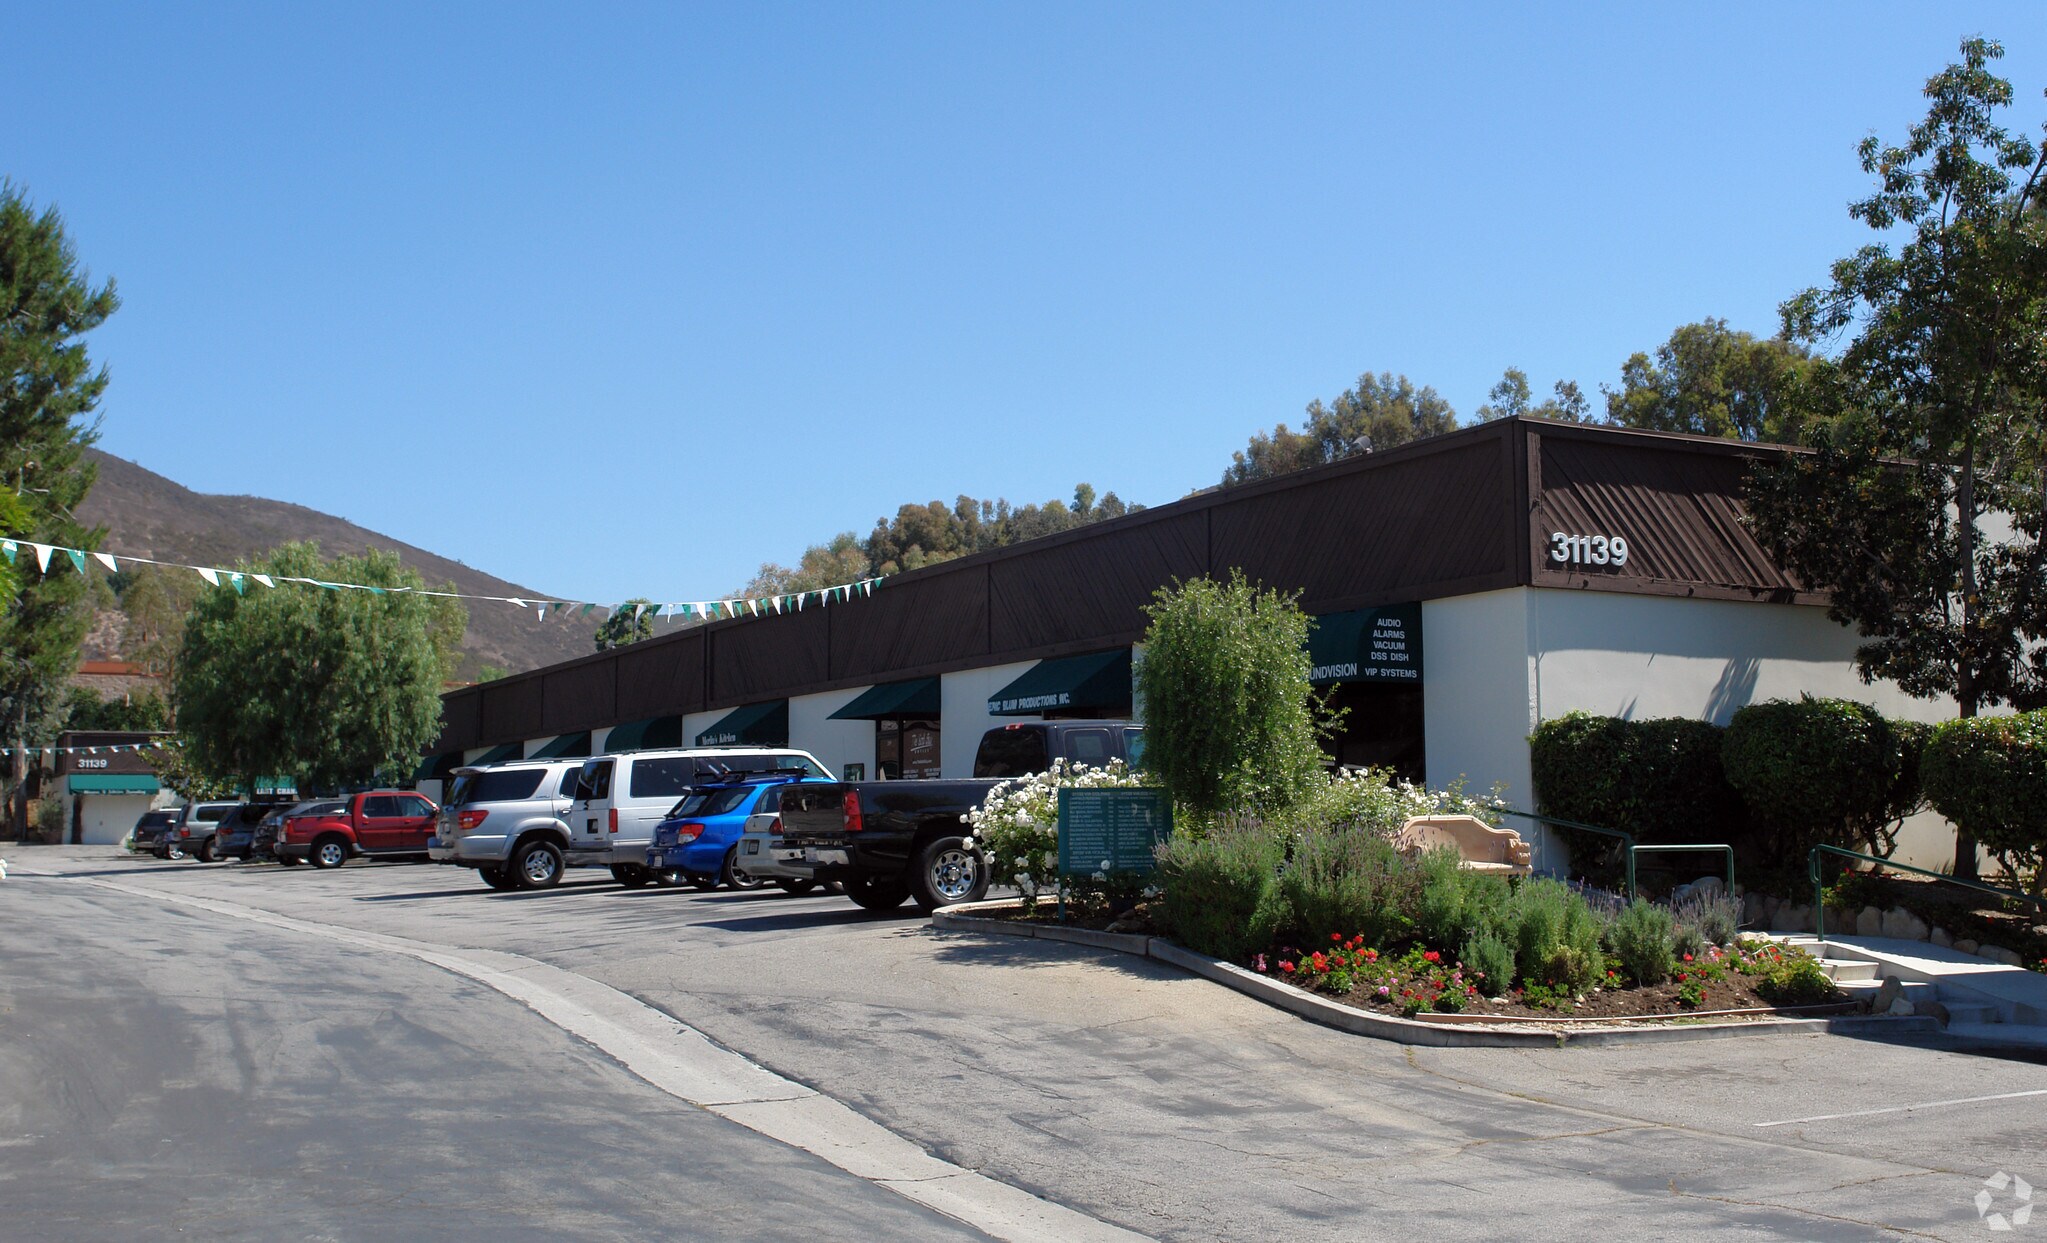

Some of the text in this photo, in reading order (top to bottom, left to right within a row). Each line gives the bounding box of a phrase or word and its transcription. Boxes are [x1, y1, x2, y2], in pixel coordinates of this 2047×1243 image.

[1551, 532, 1628, 566] 31139
[1377, 618, 1401, 627] AUDIO
[1373, 630, 1405, 639] ALARMS
[1373, 641, 1405, 650] VACUUM
[1371, 652, 1409, 662] DSS DISH
[1302, 663, 1357, 680] UNDVISION
[1365, 668, 1417, 678] VIP SYSTEMS
[1018, 693, 1057, 709] PRODUCTIONS
[78, 759, 107, 768] 31139
